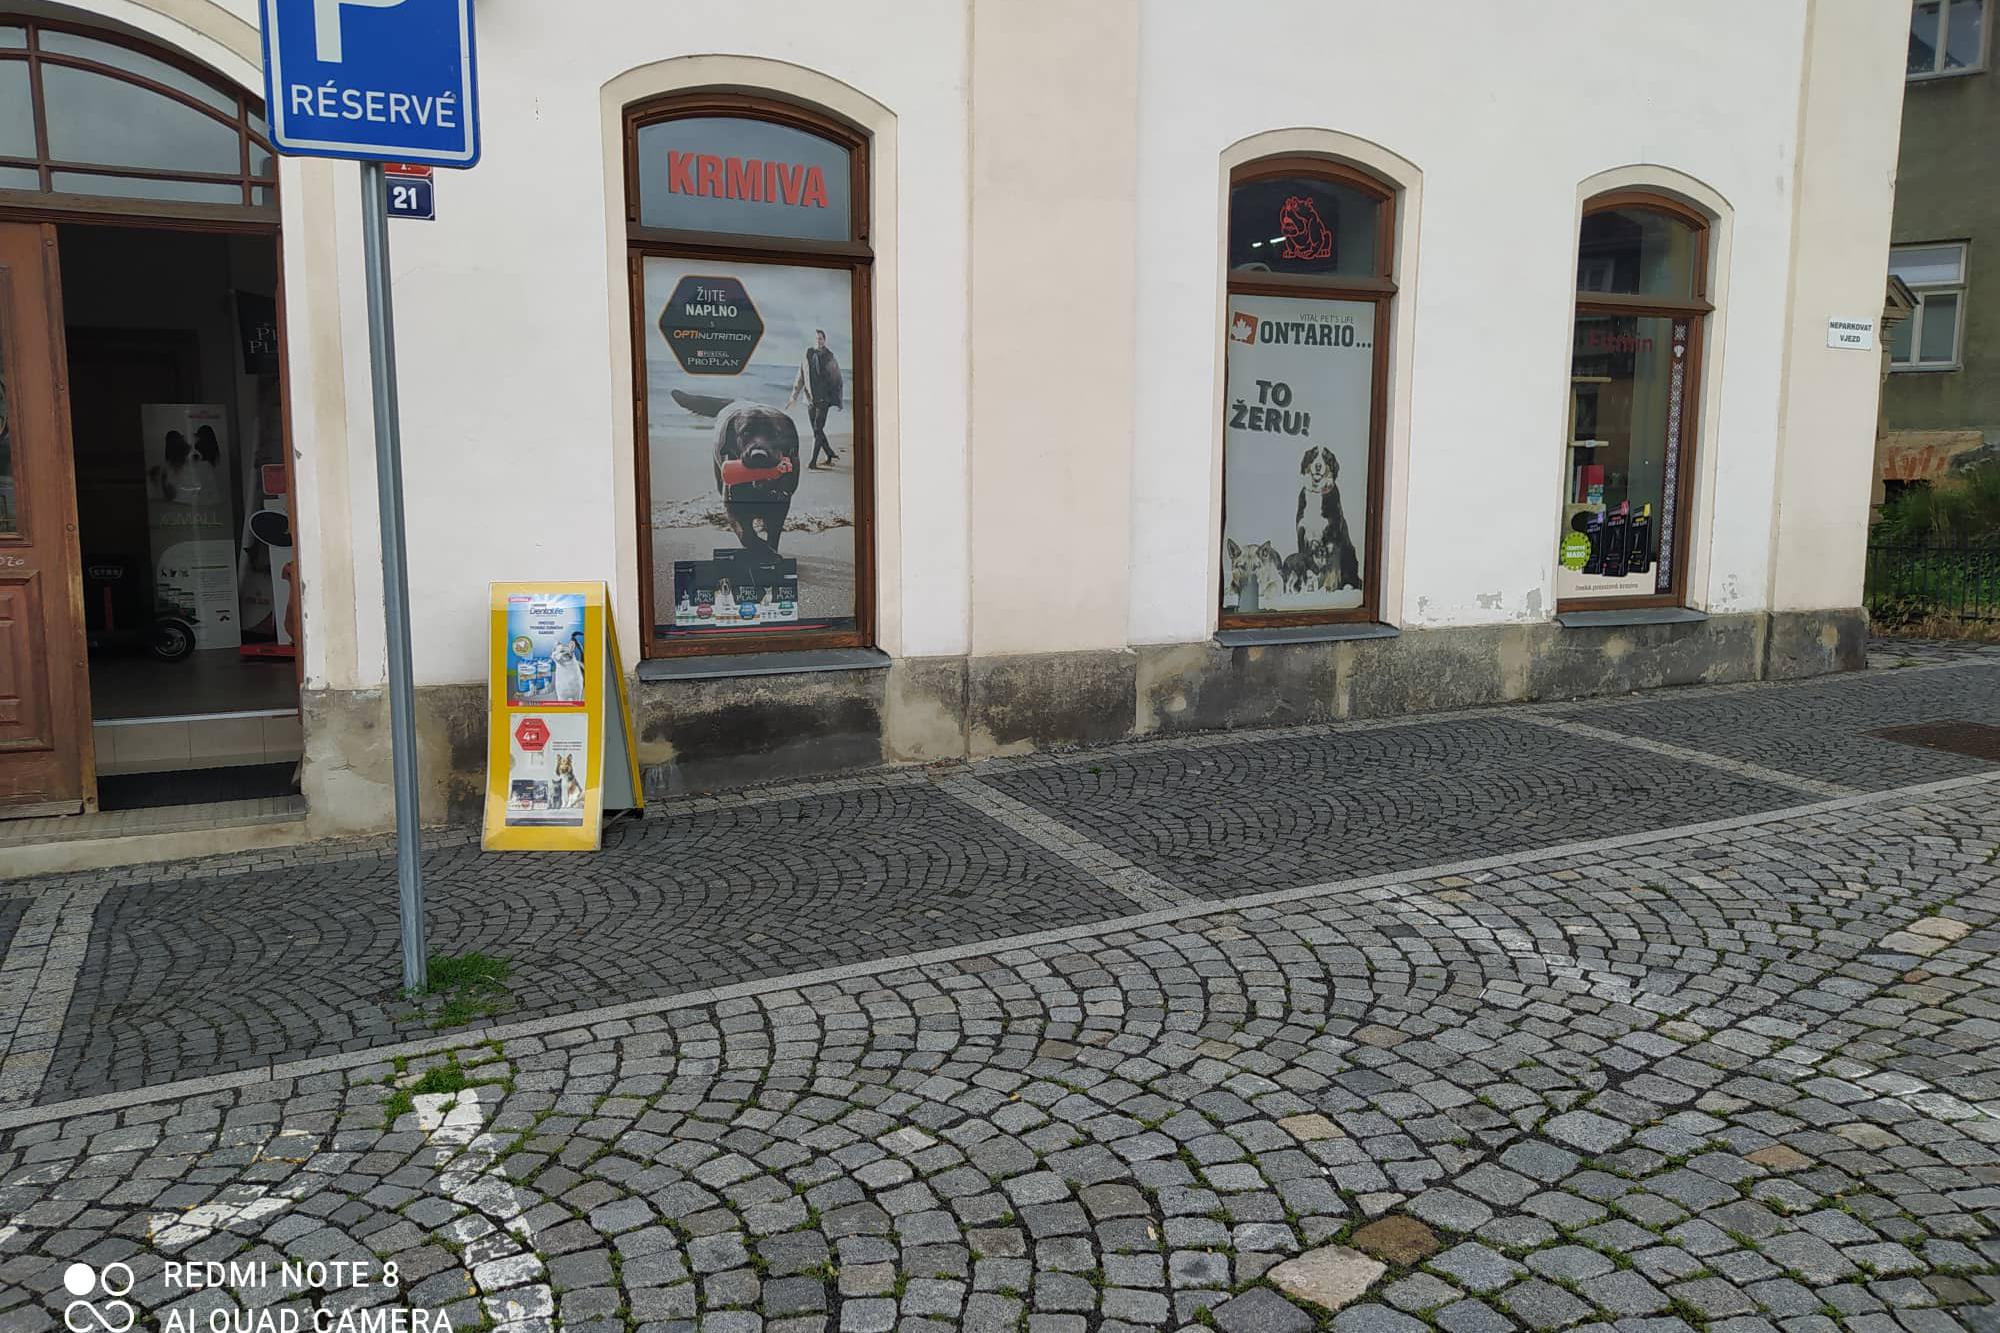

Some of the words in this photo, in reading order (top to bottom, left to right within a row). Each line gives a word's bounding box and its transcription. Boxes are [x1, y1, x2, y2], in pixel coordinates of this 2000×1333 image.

[291, 80, 456, 128] RÉSERVÉ
[667, 150, 828, 208] KRMIVA
[392, 186, 417, 210] 21
[696, 286, 726, 302] ŽIJTE
[685, 303, 737, 317] NAPLNO
[673, 330, 751, 341] OPTINUTRITION
[1829, 322, 1872, 332] NEPARKOVAT
[1839, 335, 1861, 343] VJEZD
[1256, 380, 1293, 408] TO
[1229, 399, 1311, 437] ŽERU!
